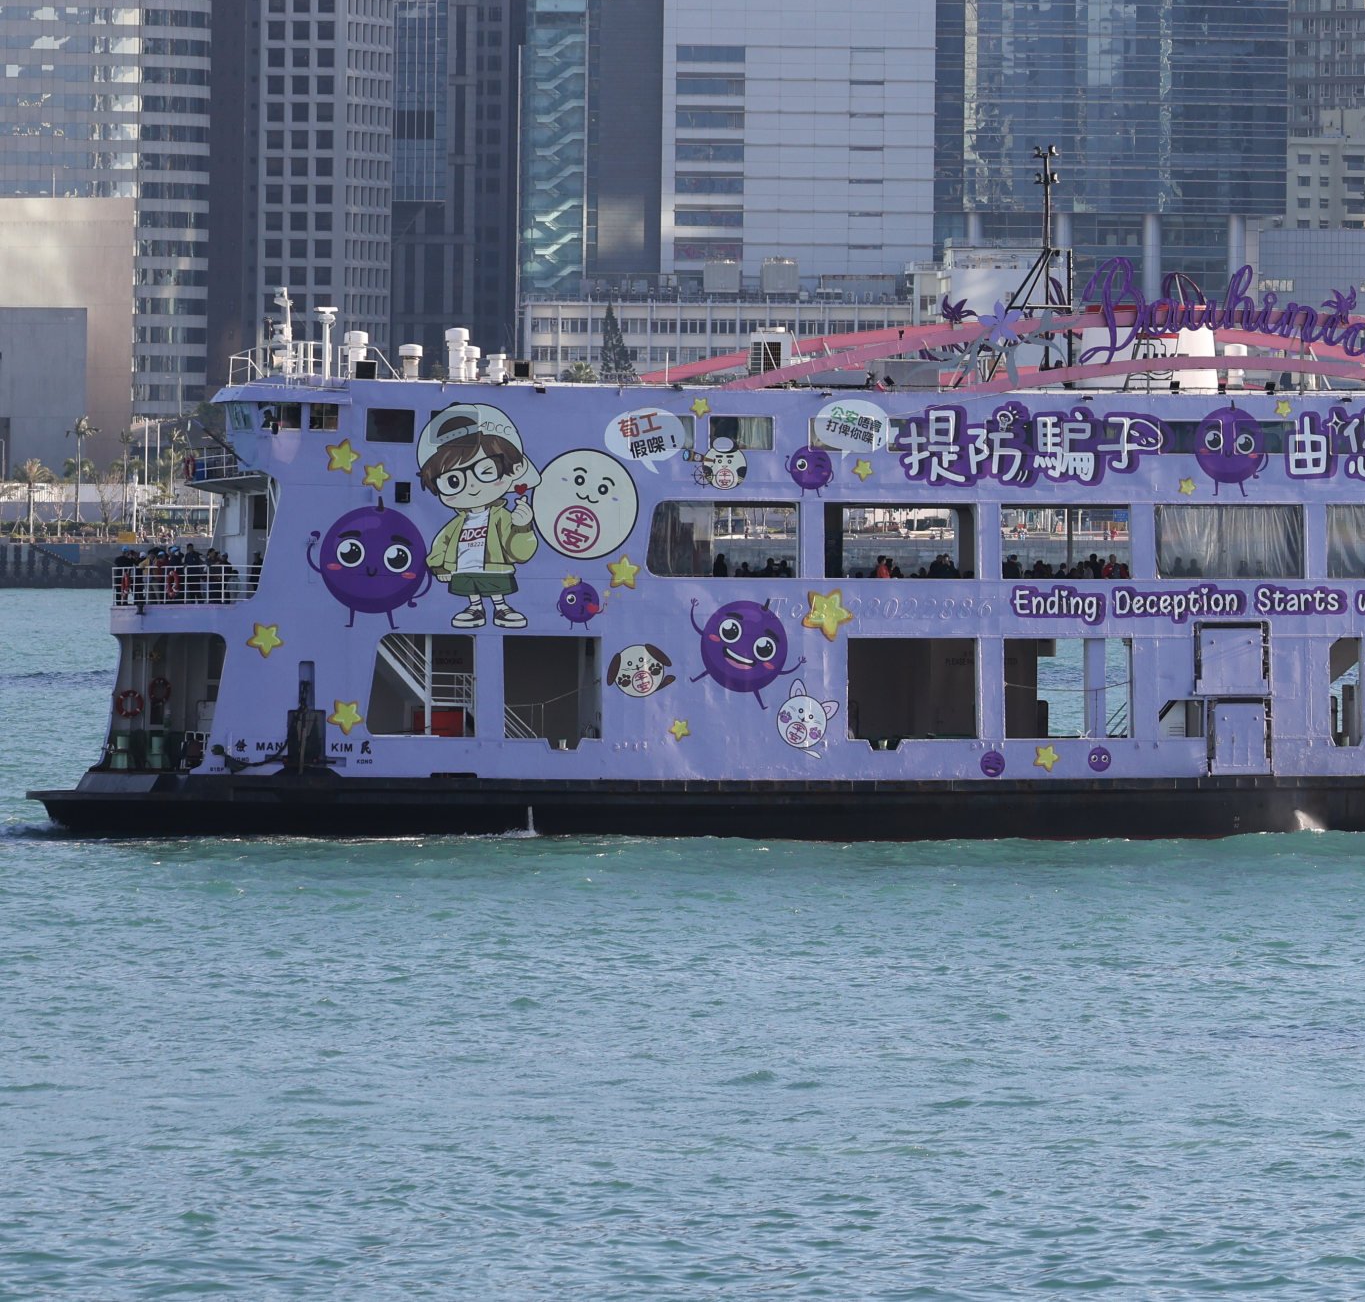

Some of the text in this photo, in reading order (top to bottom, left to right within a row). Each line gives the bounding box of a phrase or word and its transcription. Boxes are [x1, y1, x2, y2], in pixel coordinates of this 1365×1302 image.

[480, 422, 513, 436] ADCC
[900, 409, 1150, 482] 提防騙子
[459, 527, 487, 542] ADCC
[560, 509, 595, 549] 平安
[1014, 589, 1097, 621] Ending
[1115, 588, 1238, 620] Deception
[1257, 588, 1339, 612] Starts
[256, 742, 284, 751] MAN
[331, 743, 353, 752] KIM
